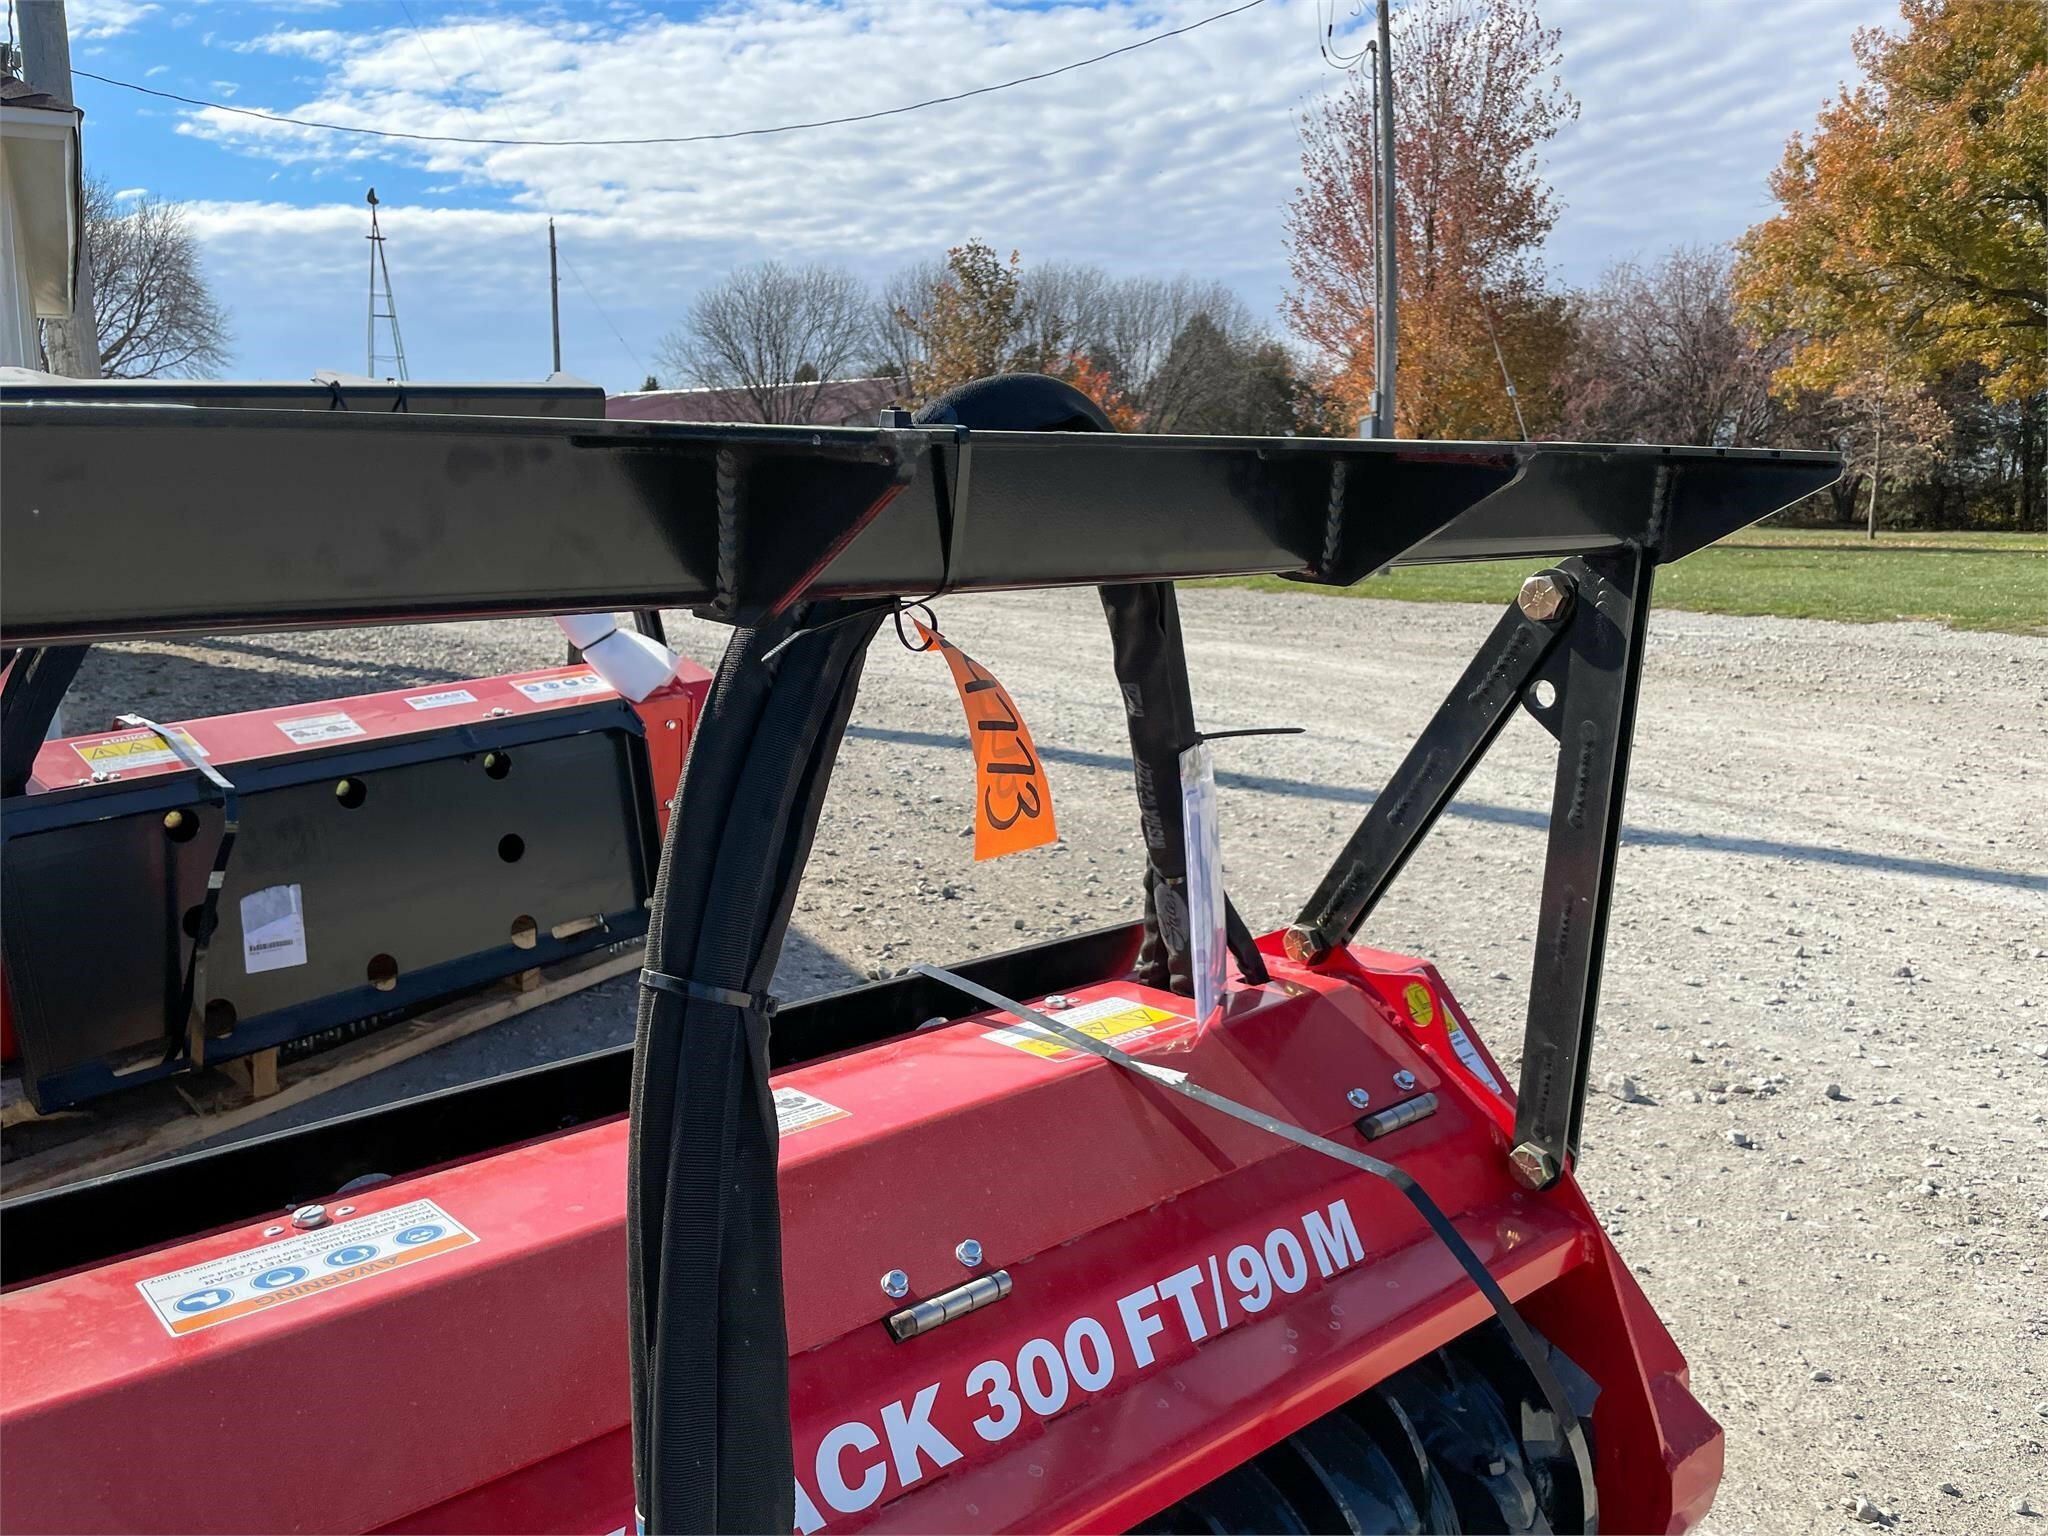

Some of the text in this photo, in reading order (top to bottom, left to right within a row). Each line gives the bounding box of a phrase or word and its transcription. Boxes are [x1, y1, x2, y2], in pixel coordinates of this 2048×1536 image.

[202, 1212, 438, 1285] WEAR APPROPRIATE SAFETY GEAR
[253, 1261, 382, 1307] WARNING
[966, 1316, 1115, 1442] 300
[1117, 1228, 1309, 1369] FT/90
[1301, 1199, 1366, 1279] M
